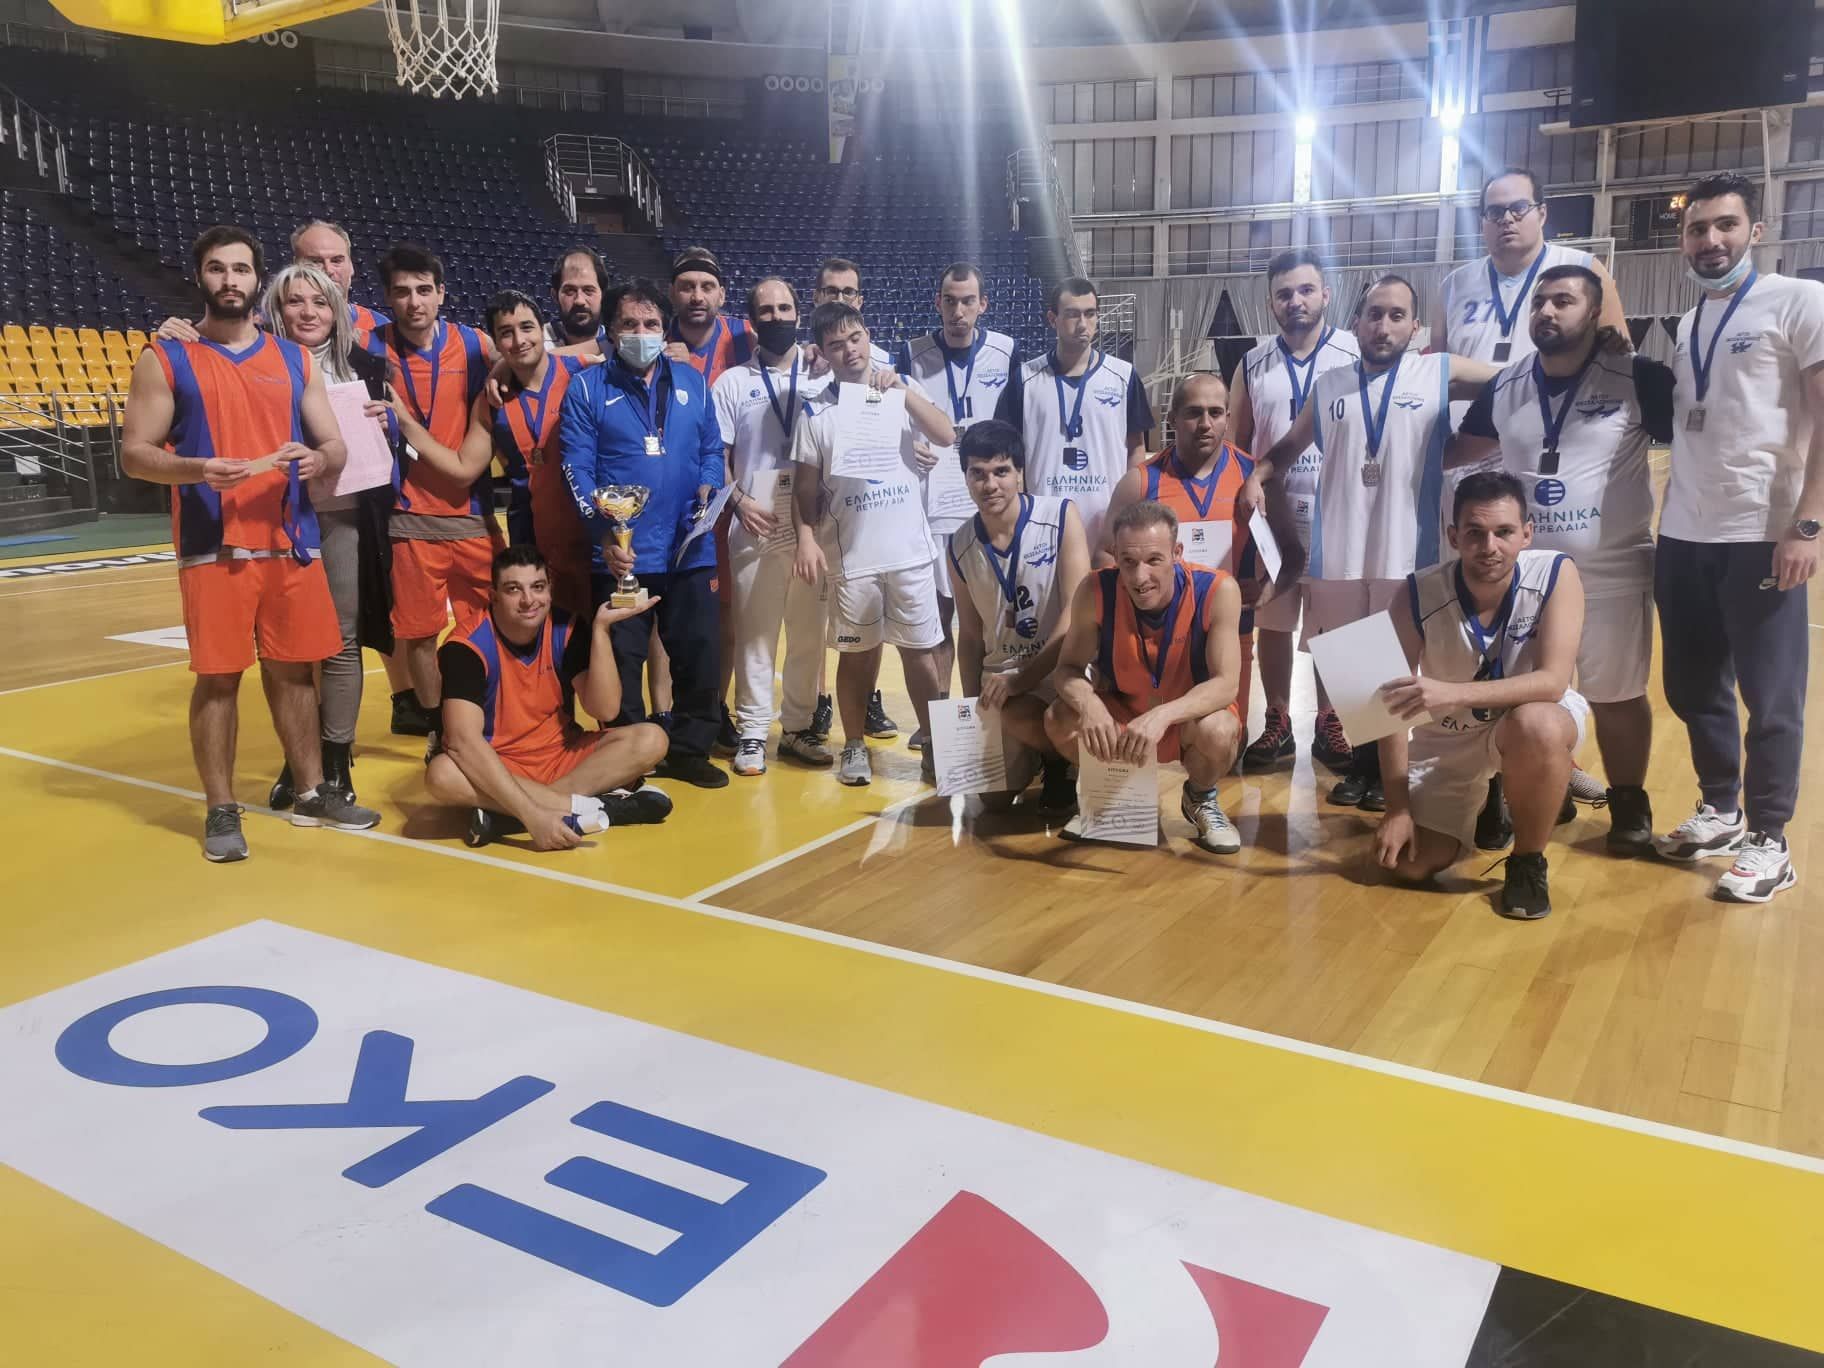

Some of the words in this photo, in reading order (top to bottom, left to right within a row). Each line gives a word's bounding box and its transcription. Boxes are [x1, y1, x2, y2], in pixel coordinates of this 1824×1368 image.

[1329, 398, 1345, 422] 10
[1046, 474, 1107, 486] ΕΛΛΗΝΙΚΑ
[844, 485, 910, 506] ΕΛΛΗΝΙΚΑ
[1526, 506, 1601, 524] ΛΗΝΙΚΑ
[1533, 522, 1588, 534] ΤΡΕΛΑΙΑ
[55, 986, 828, 1307] EKO
